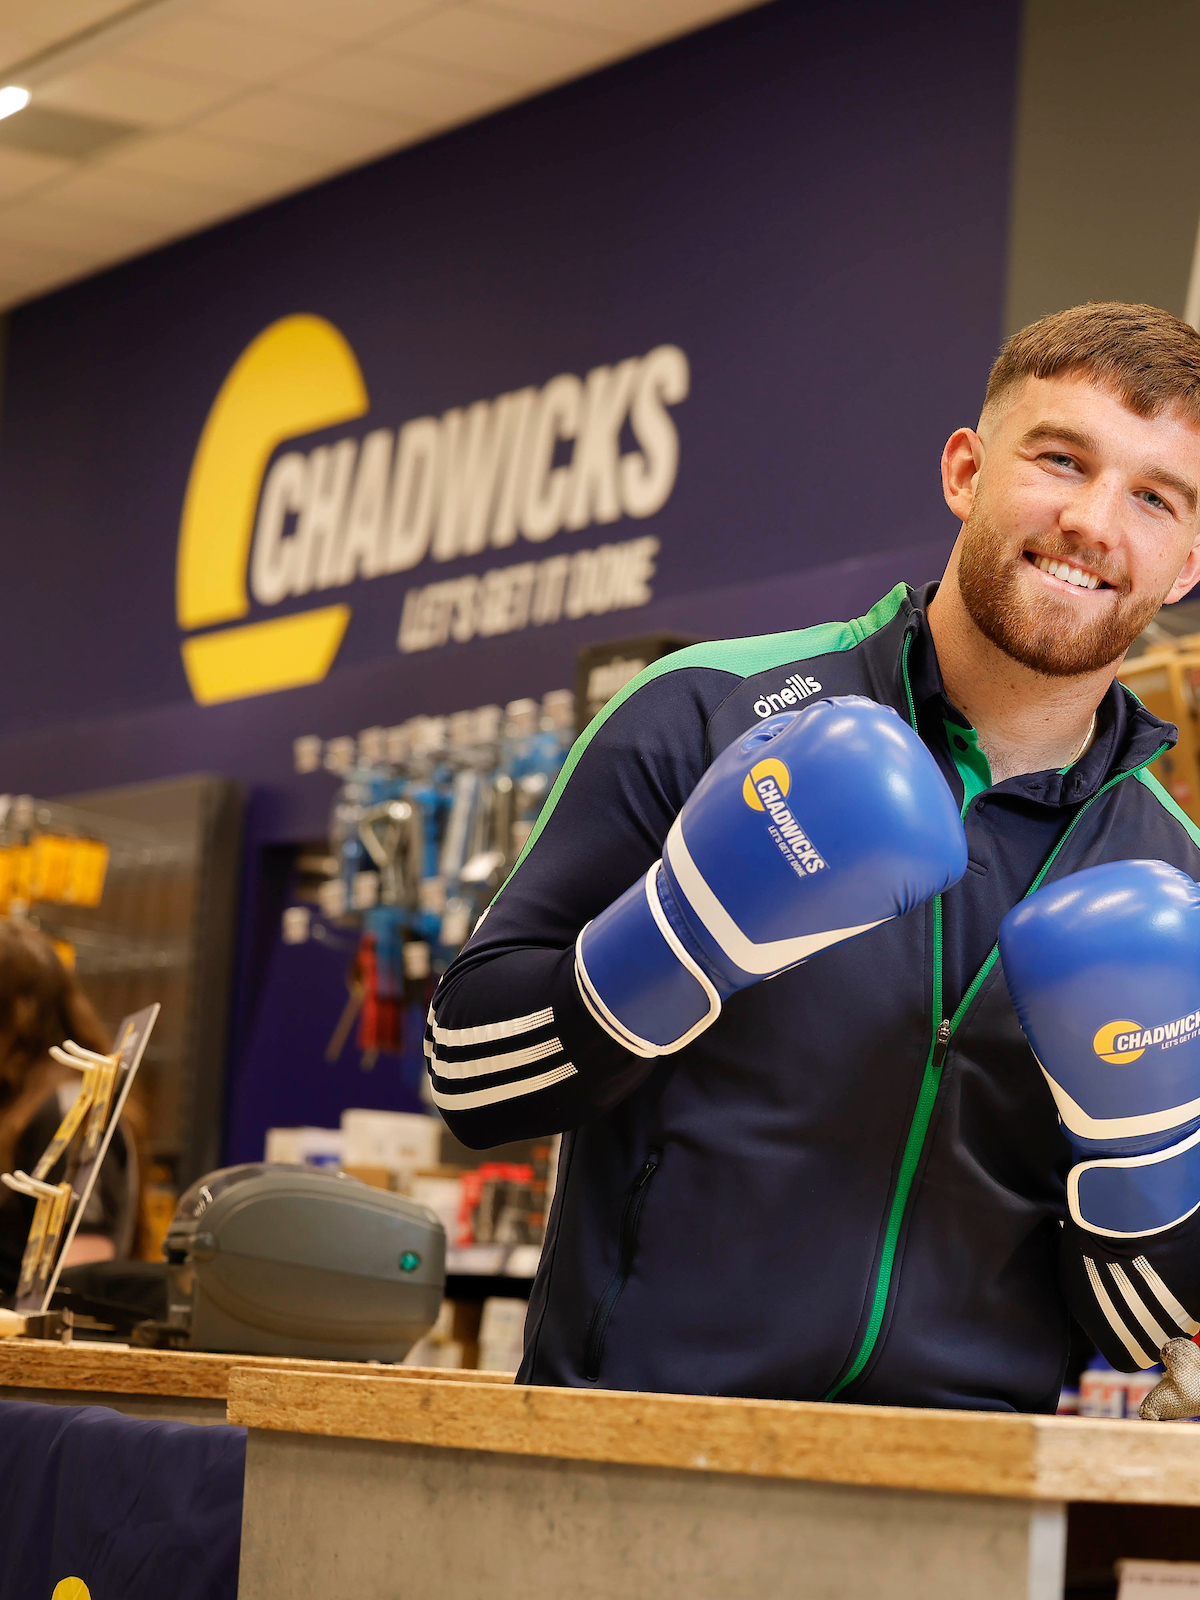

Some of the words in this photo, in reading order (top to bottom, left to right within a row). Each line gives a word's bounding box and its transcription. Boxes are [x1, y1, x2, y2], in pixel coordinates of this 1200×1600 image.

[250, 343, 691, 607] CHADWICKS
[757, 778, 825, 874] CHADWICKS
[768, 825, 783, 843] LET'S
[778, 841, 791, 855] GET
[786, 853, 796, 861] IT
[790, 860, 807, 878] DONE
[1161, 1038, 1179, 1050] LET'S
[1179, 1033, 1191, 1044] GET
[1191, 1030, 1198, 1038] IT
